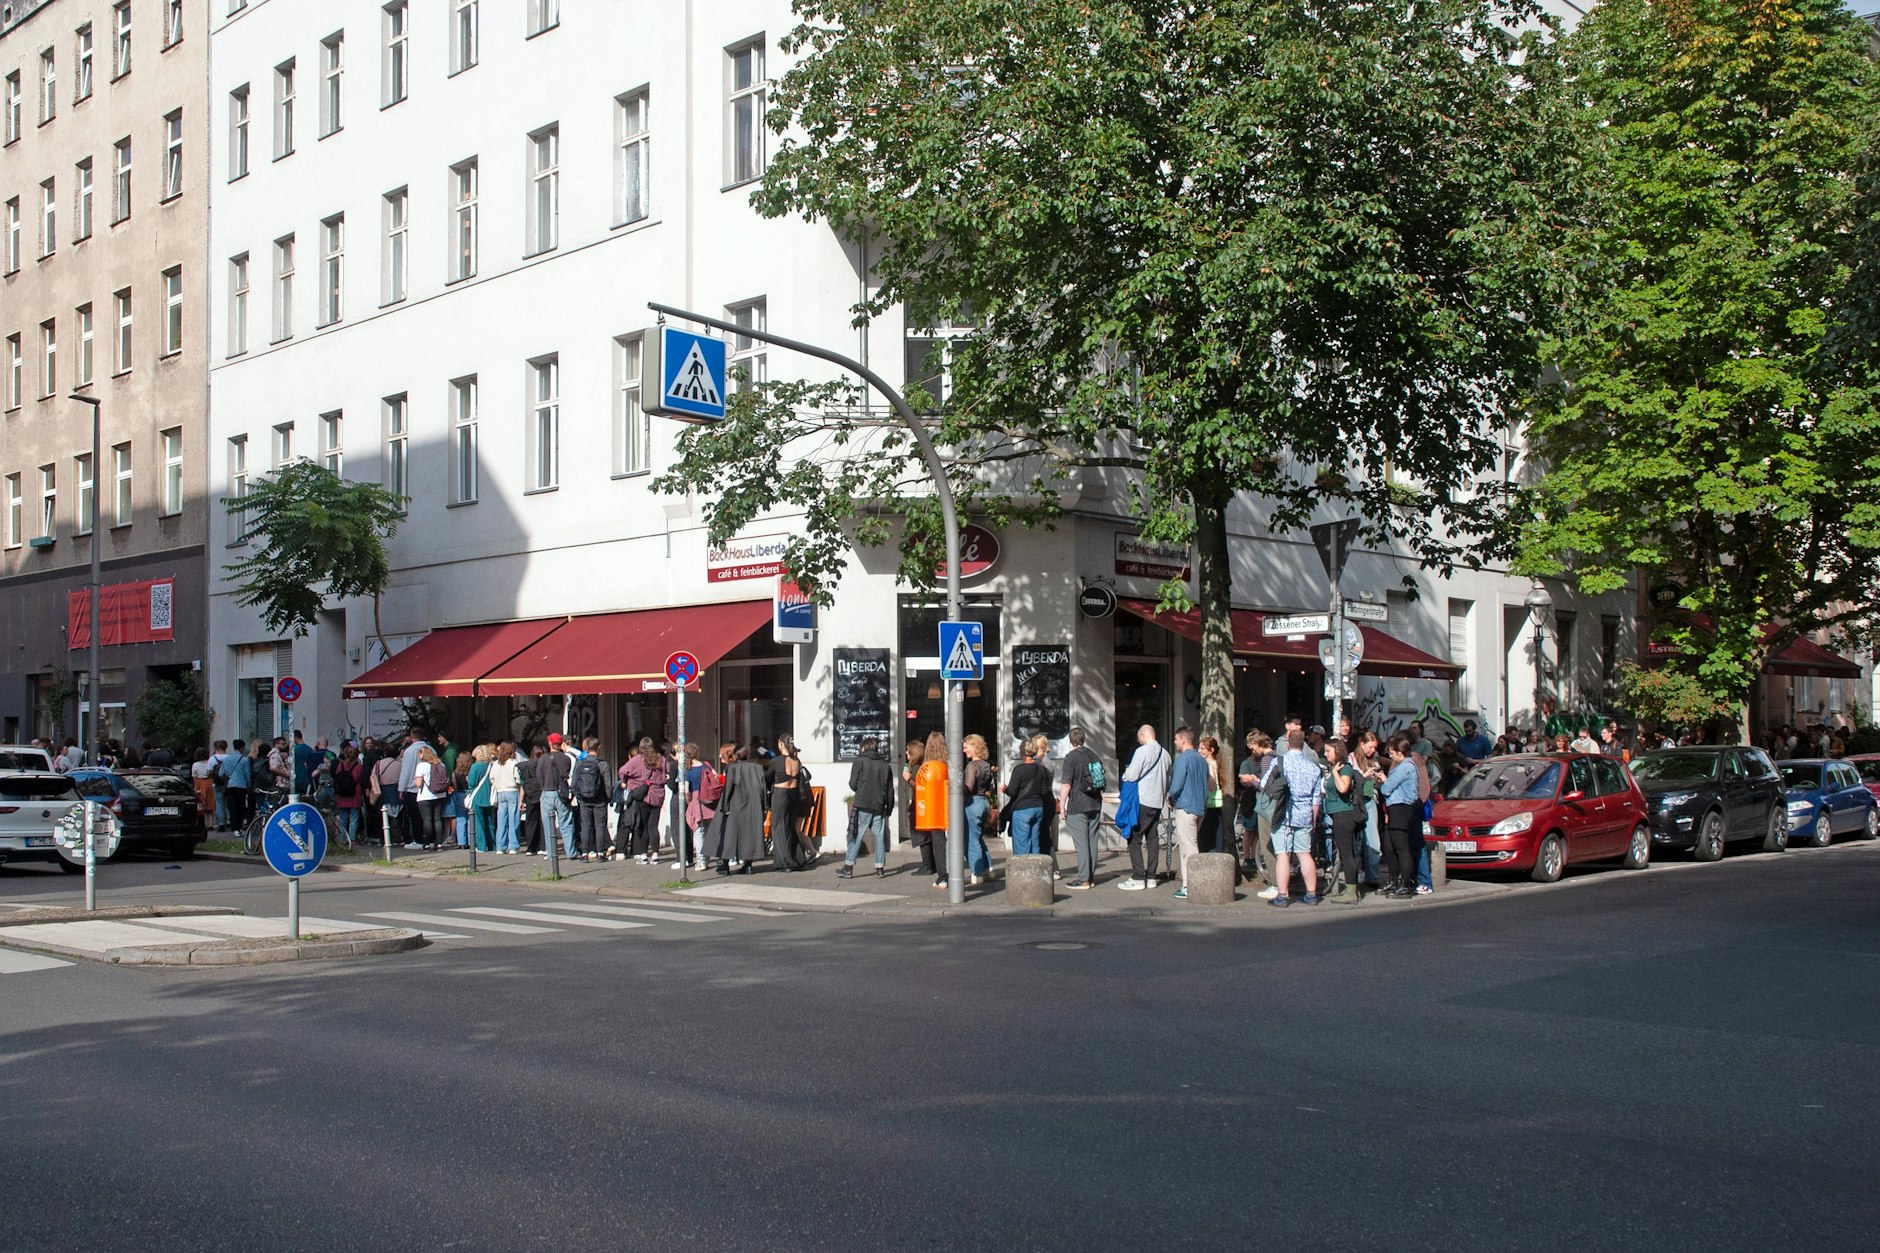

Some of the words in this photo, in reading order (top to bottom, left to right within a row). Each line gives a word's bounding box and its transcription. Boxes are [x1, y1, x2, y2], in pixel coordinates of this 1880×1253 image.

[717, 569, 732, 579] café
[733, 568, 739, 577] &
[740, 564, 779, 577] feinbäckerei
[1657, 590, 1675, 601] JEVER
